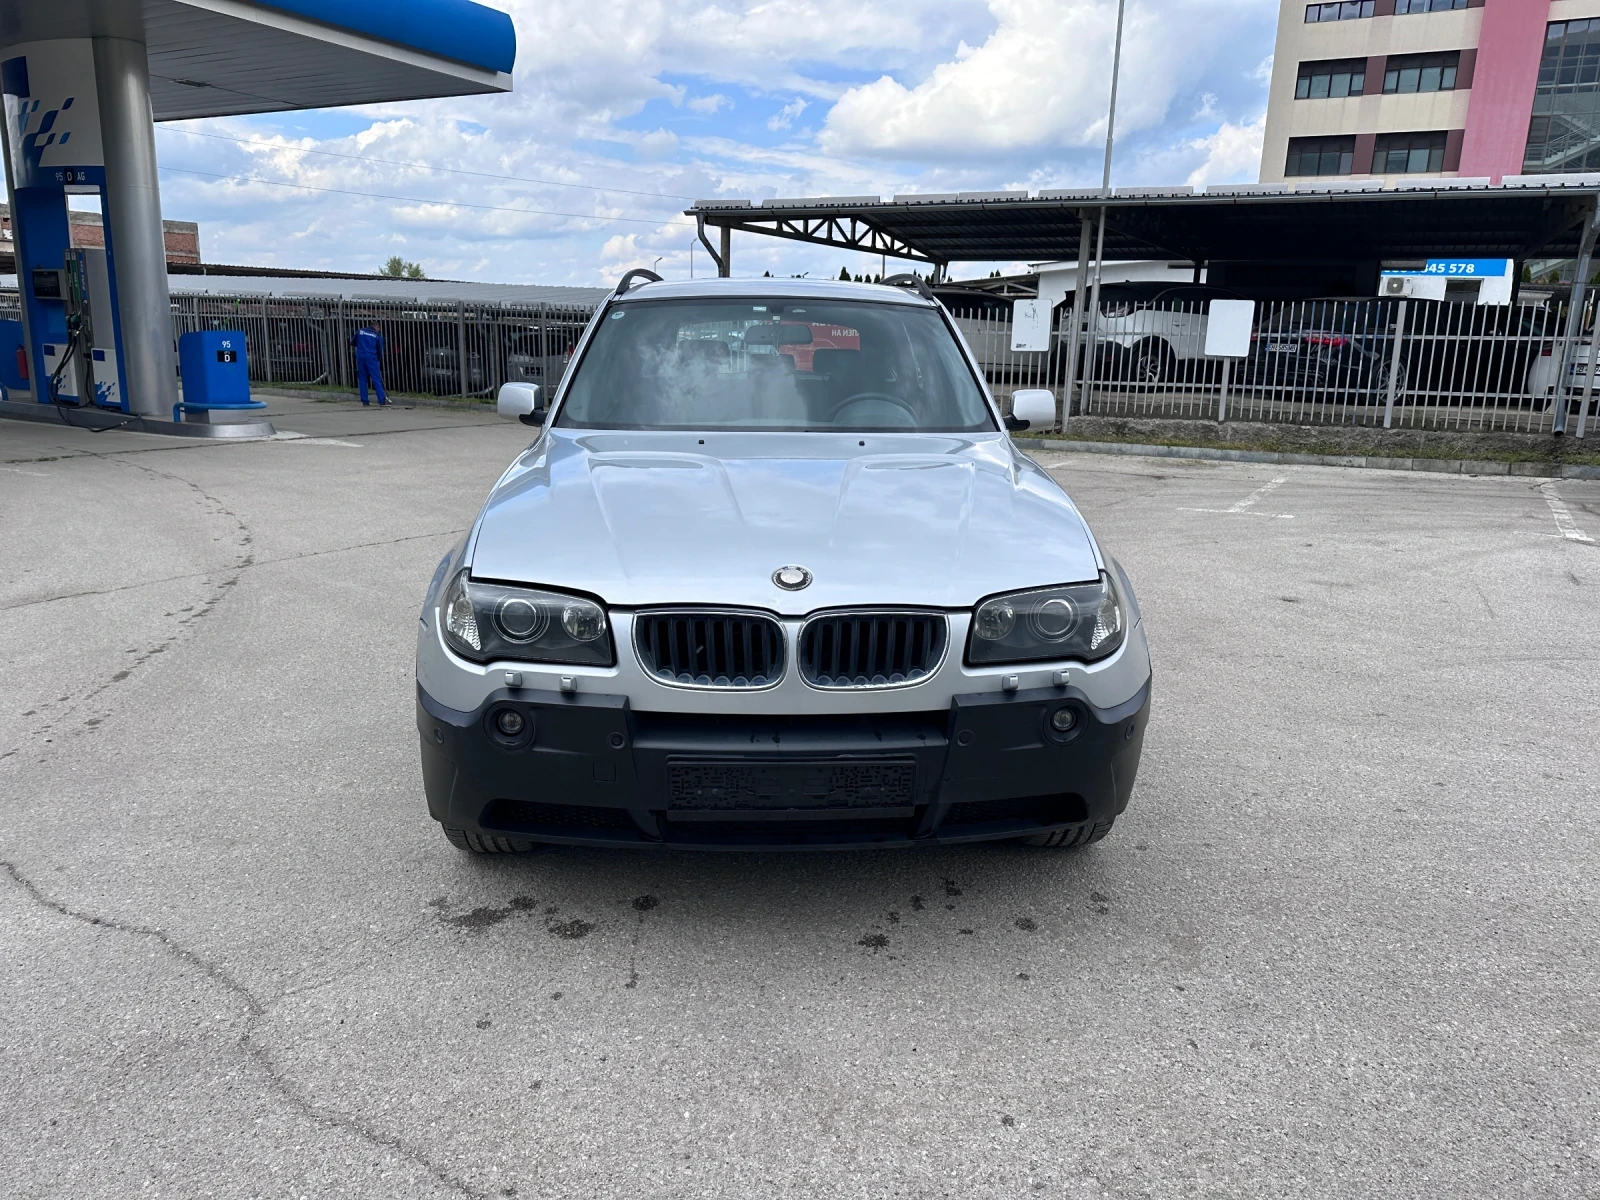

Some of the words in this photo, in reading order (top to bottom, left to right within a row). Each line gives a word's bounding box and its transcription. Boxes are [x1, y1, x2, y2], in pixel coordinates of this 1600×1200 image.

[55, 172, 64, 181] 95
[66, 172, 72, 181] D
[77, 171, 86, 181] AG
[1448, 264, 1475, 273] 578
